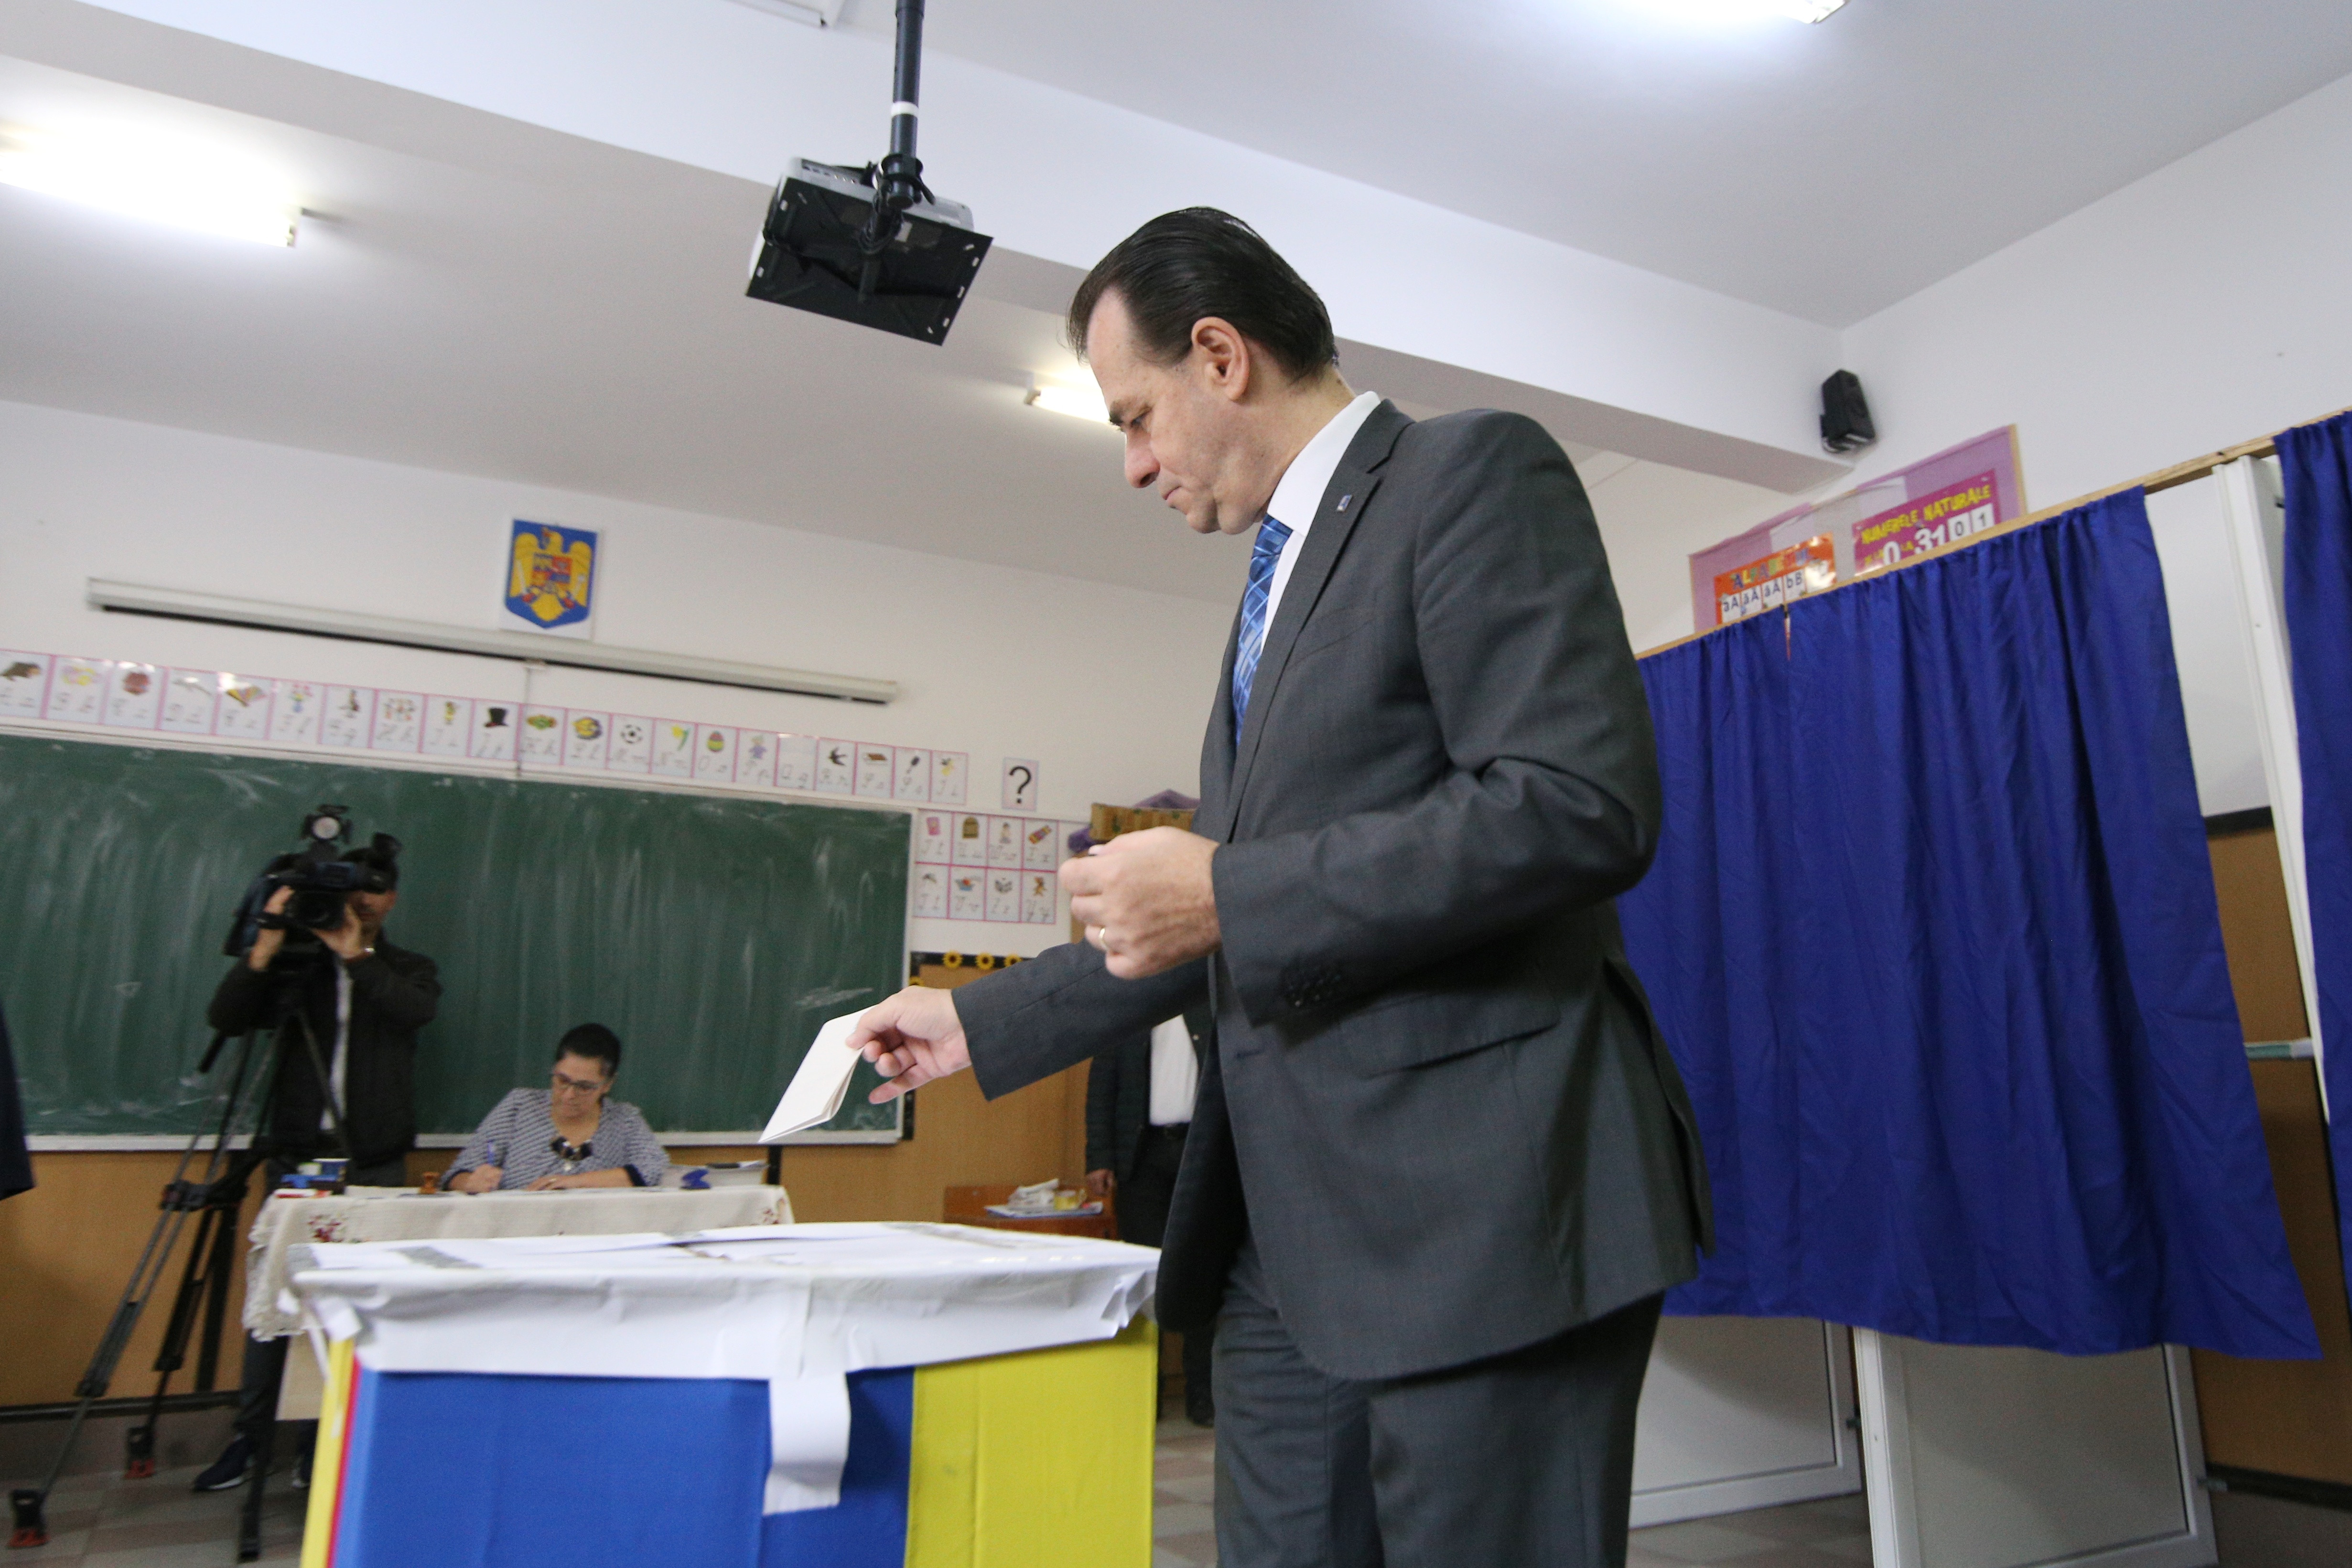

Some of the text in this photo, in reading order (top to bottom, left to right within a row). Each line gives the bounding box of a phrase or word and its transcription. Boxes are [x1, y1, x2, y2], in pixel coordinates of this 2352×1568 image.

[1978, 512, 1986, 527] 1
[1955, 521, 1964, 536] 0
[1009, 765, 1032, 804] ?
